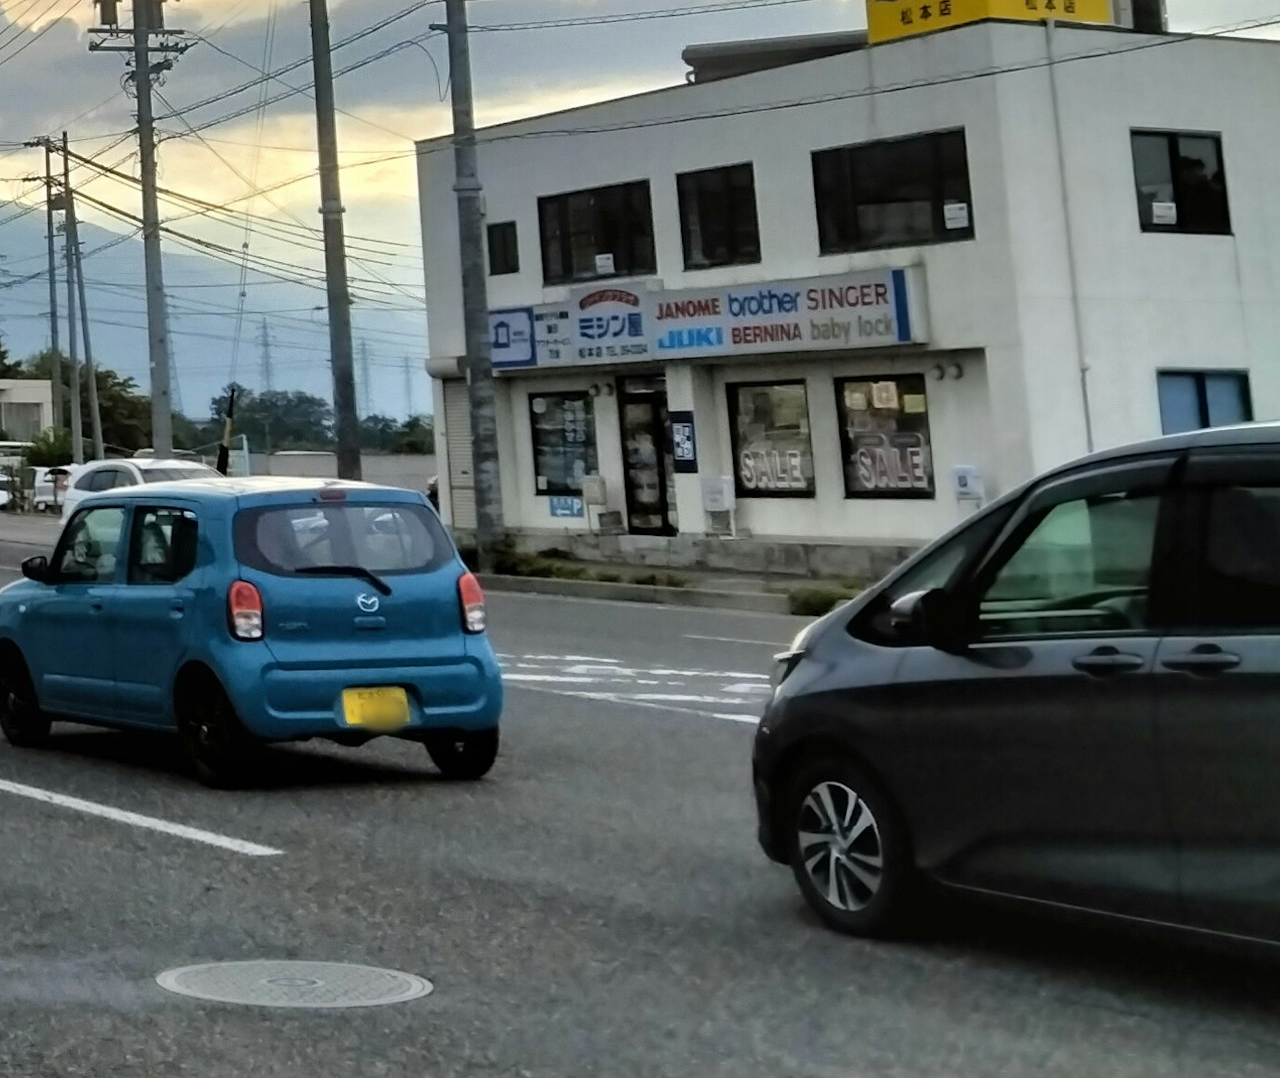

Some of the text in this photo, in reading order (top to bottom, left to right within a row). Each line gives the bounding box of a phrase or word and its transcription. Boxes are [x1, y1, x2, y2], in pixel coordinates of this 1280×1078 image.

[900, 0, 952, 25] 松本店
[656, 297, 722, 320] JANOME
[727, 290, 802, 317] brother
[806, 283, 889, 311] SINGER
[657, 315, 896, 349] JUKI BERNINA baby lock
[740, 449, 808, 489] SALE
[855, 447, 929, 489] SALE
[573, 498, 582, 514] P
